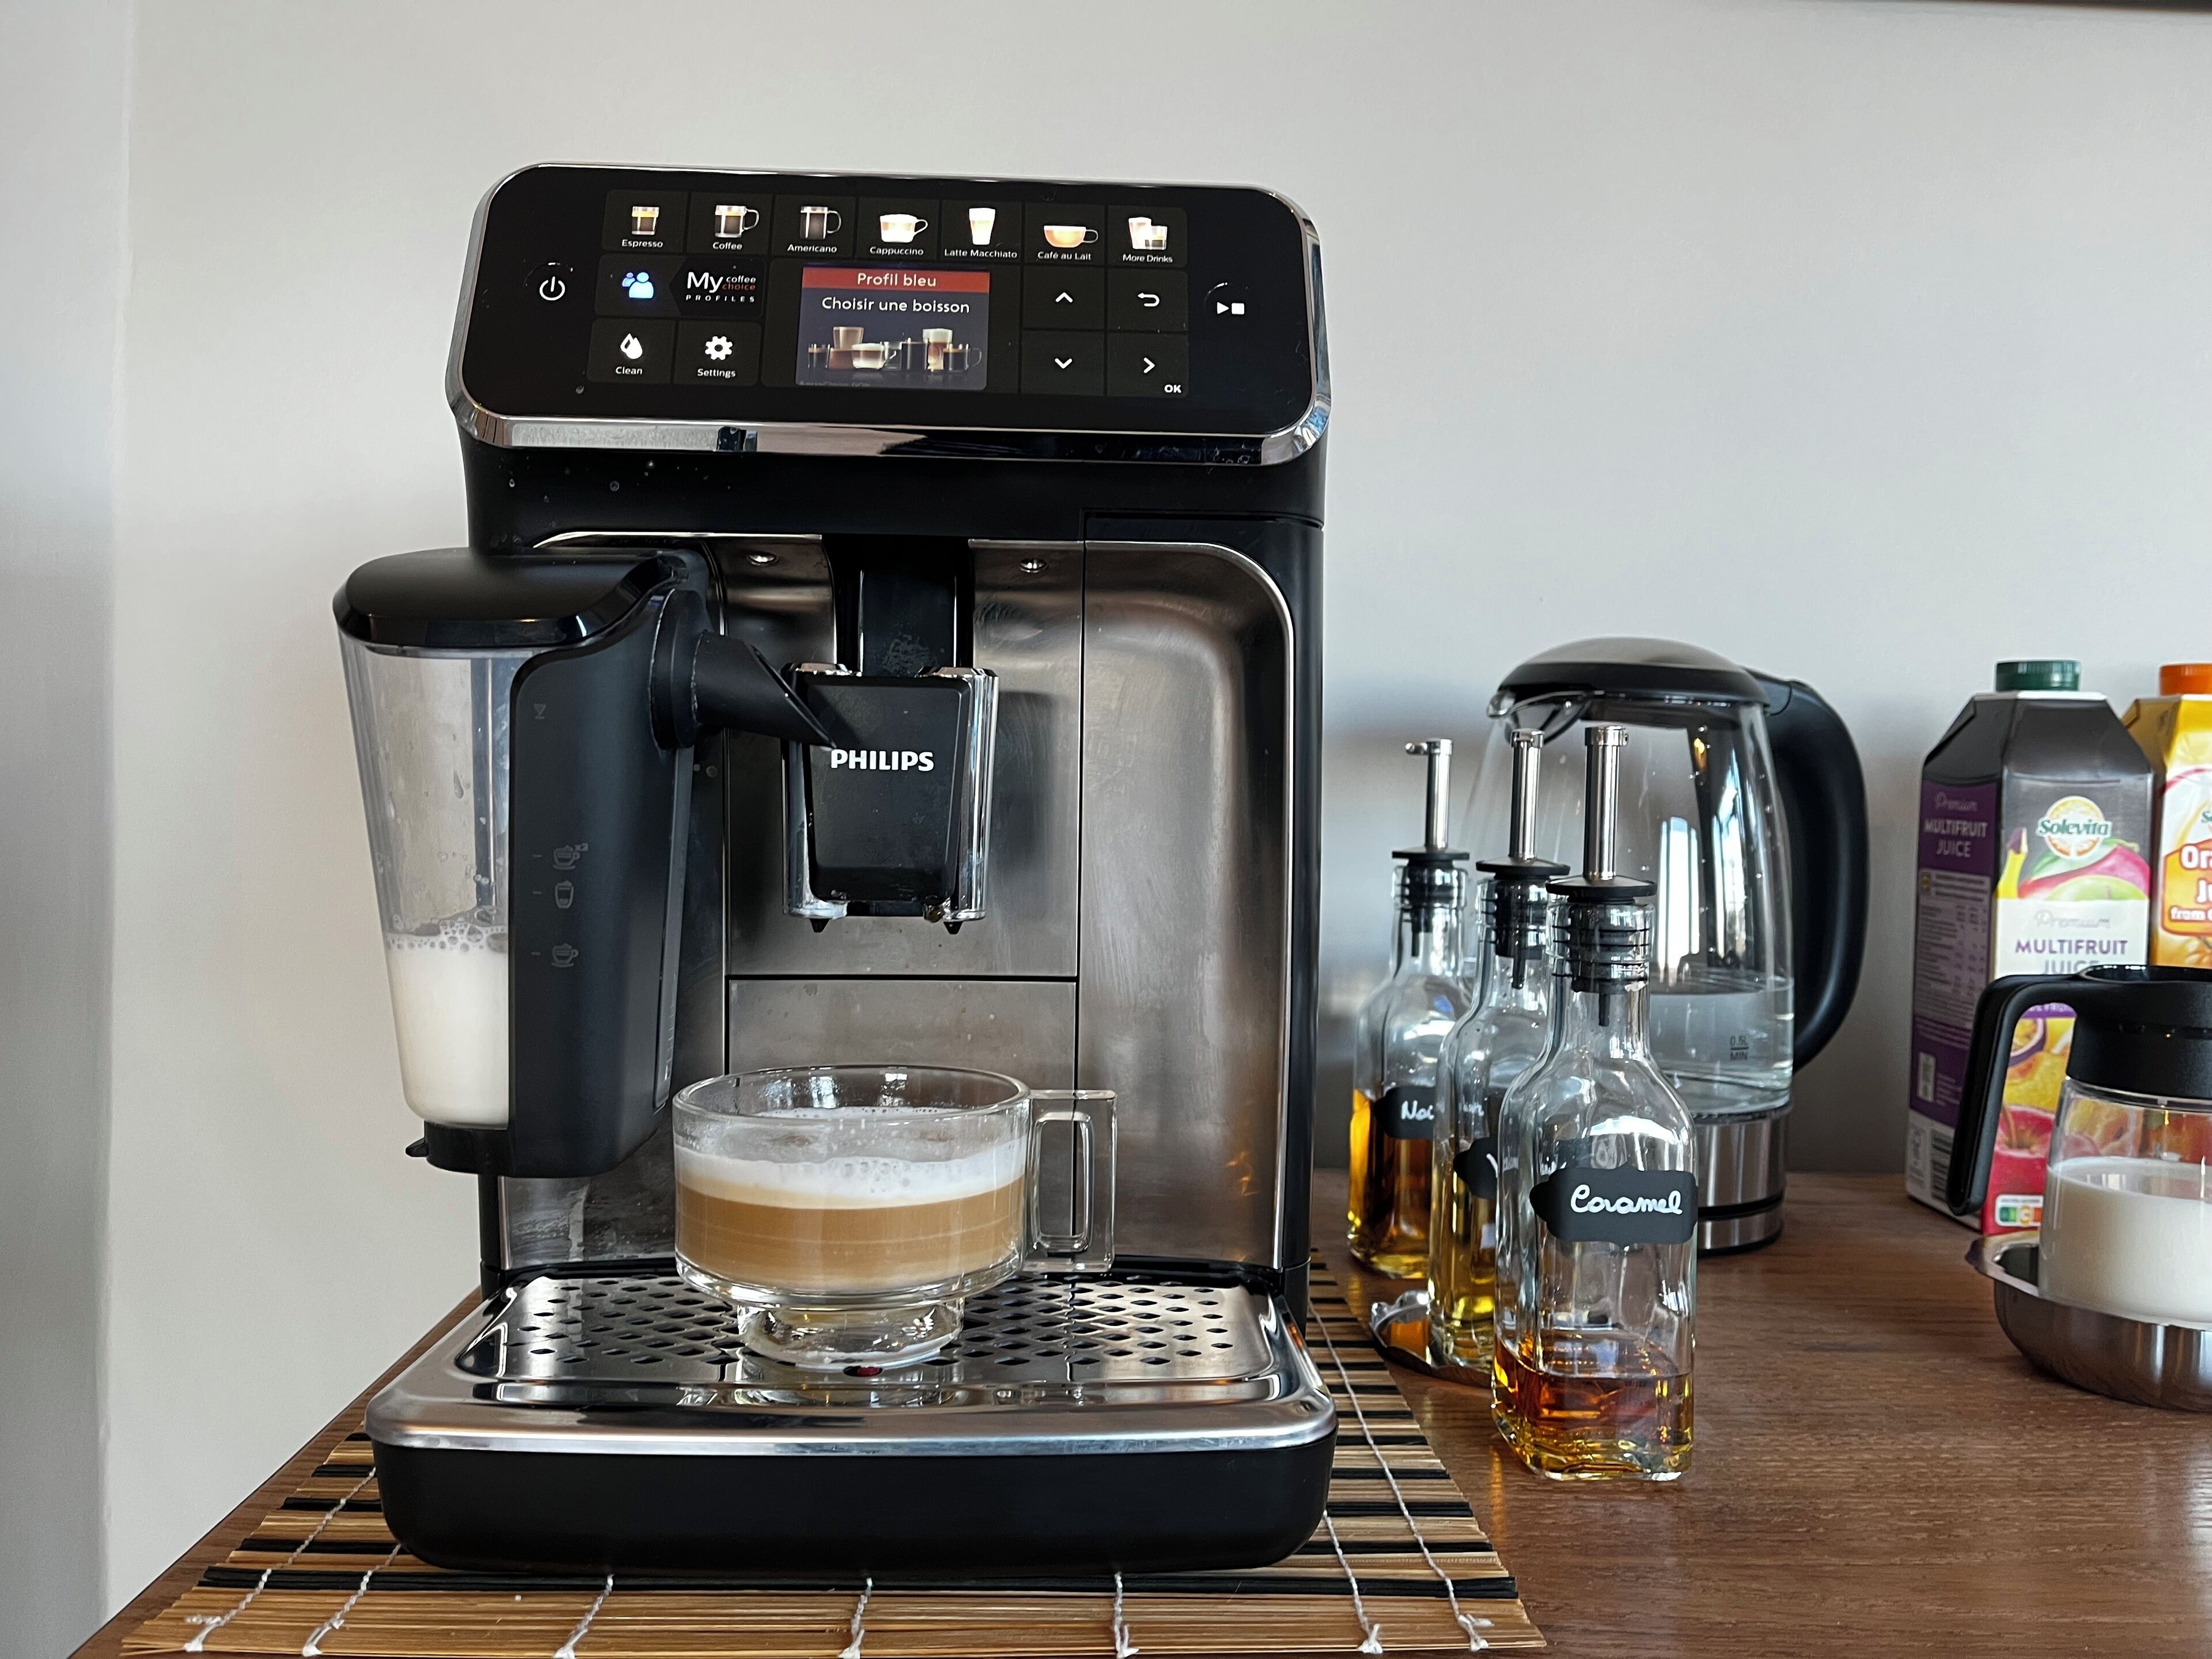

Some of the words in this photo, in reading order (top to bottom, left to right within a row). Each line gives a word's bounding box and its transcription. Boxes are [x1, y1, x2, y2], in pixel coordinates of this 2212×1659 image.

[622, 239, 664, 248] Espresso
[713, 241, 743, 250] Coffee
[787, 244, 837, 253] Americano
[870, 246, 924, 256] Cappuccino
[944, 248, 968, 257] Latte
[970, 249, 1017, 259] Macchiato
[1037, 251, 1059, 260] Café
[1075, 252, 1091, 260] Lait
[1123, 254, 1145, 262] More
[1146, 255, 1173, 263] Drinks
[687, 271, 724, 293] My
[726, 275, 756, 283] coffee
[857, 272, 898, 286] Profil
[903, 273, 936, 287] bleu
[722, 281, 756, 290] choice
[685, 294, 755, 302] PROFILES
[822, 297, 874, 310] Choisir
[879, 301, 908, 312] une
[912, 298, 969, 313] boisson
[615, 366, 643, 375] Clean
[697, 368, 736, 378] Settings
[1164, 384, 1181, 393] OK
[831, 749, 934, 771] PHILIPS
[1924, 817, 1988, 838] MULTIFRUIT
[2039, 819, 2109, 835] Solevita
[1936, 839, 1971, 858] JUICE
[2181, 845, 2212, 869] Or
[2016, 939, 2128, 955] MULTIFRUIT
[2042, 960, 2100, 975] JUIC
[1730, 1051, 1748, 1060] MIN
[1401, 1100, 1435, 1120] Noi
[1570, 1184, 1683, 1215] Caramel
